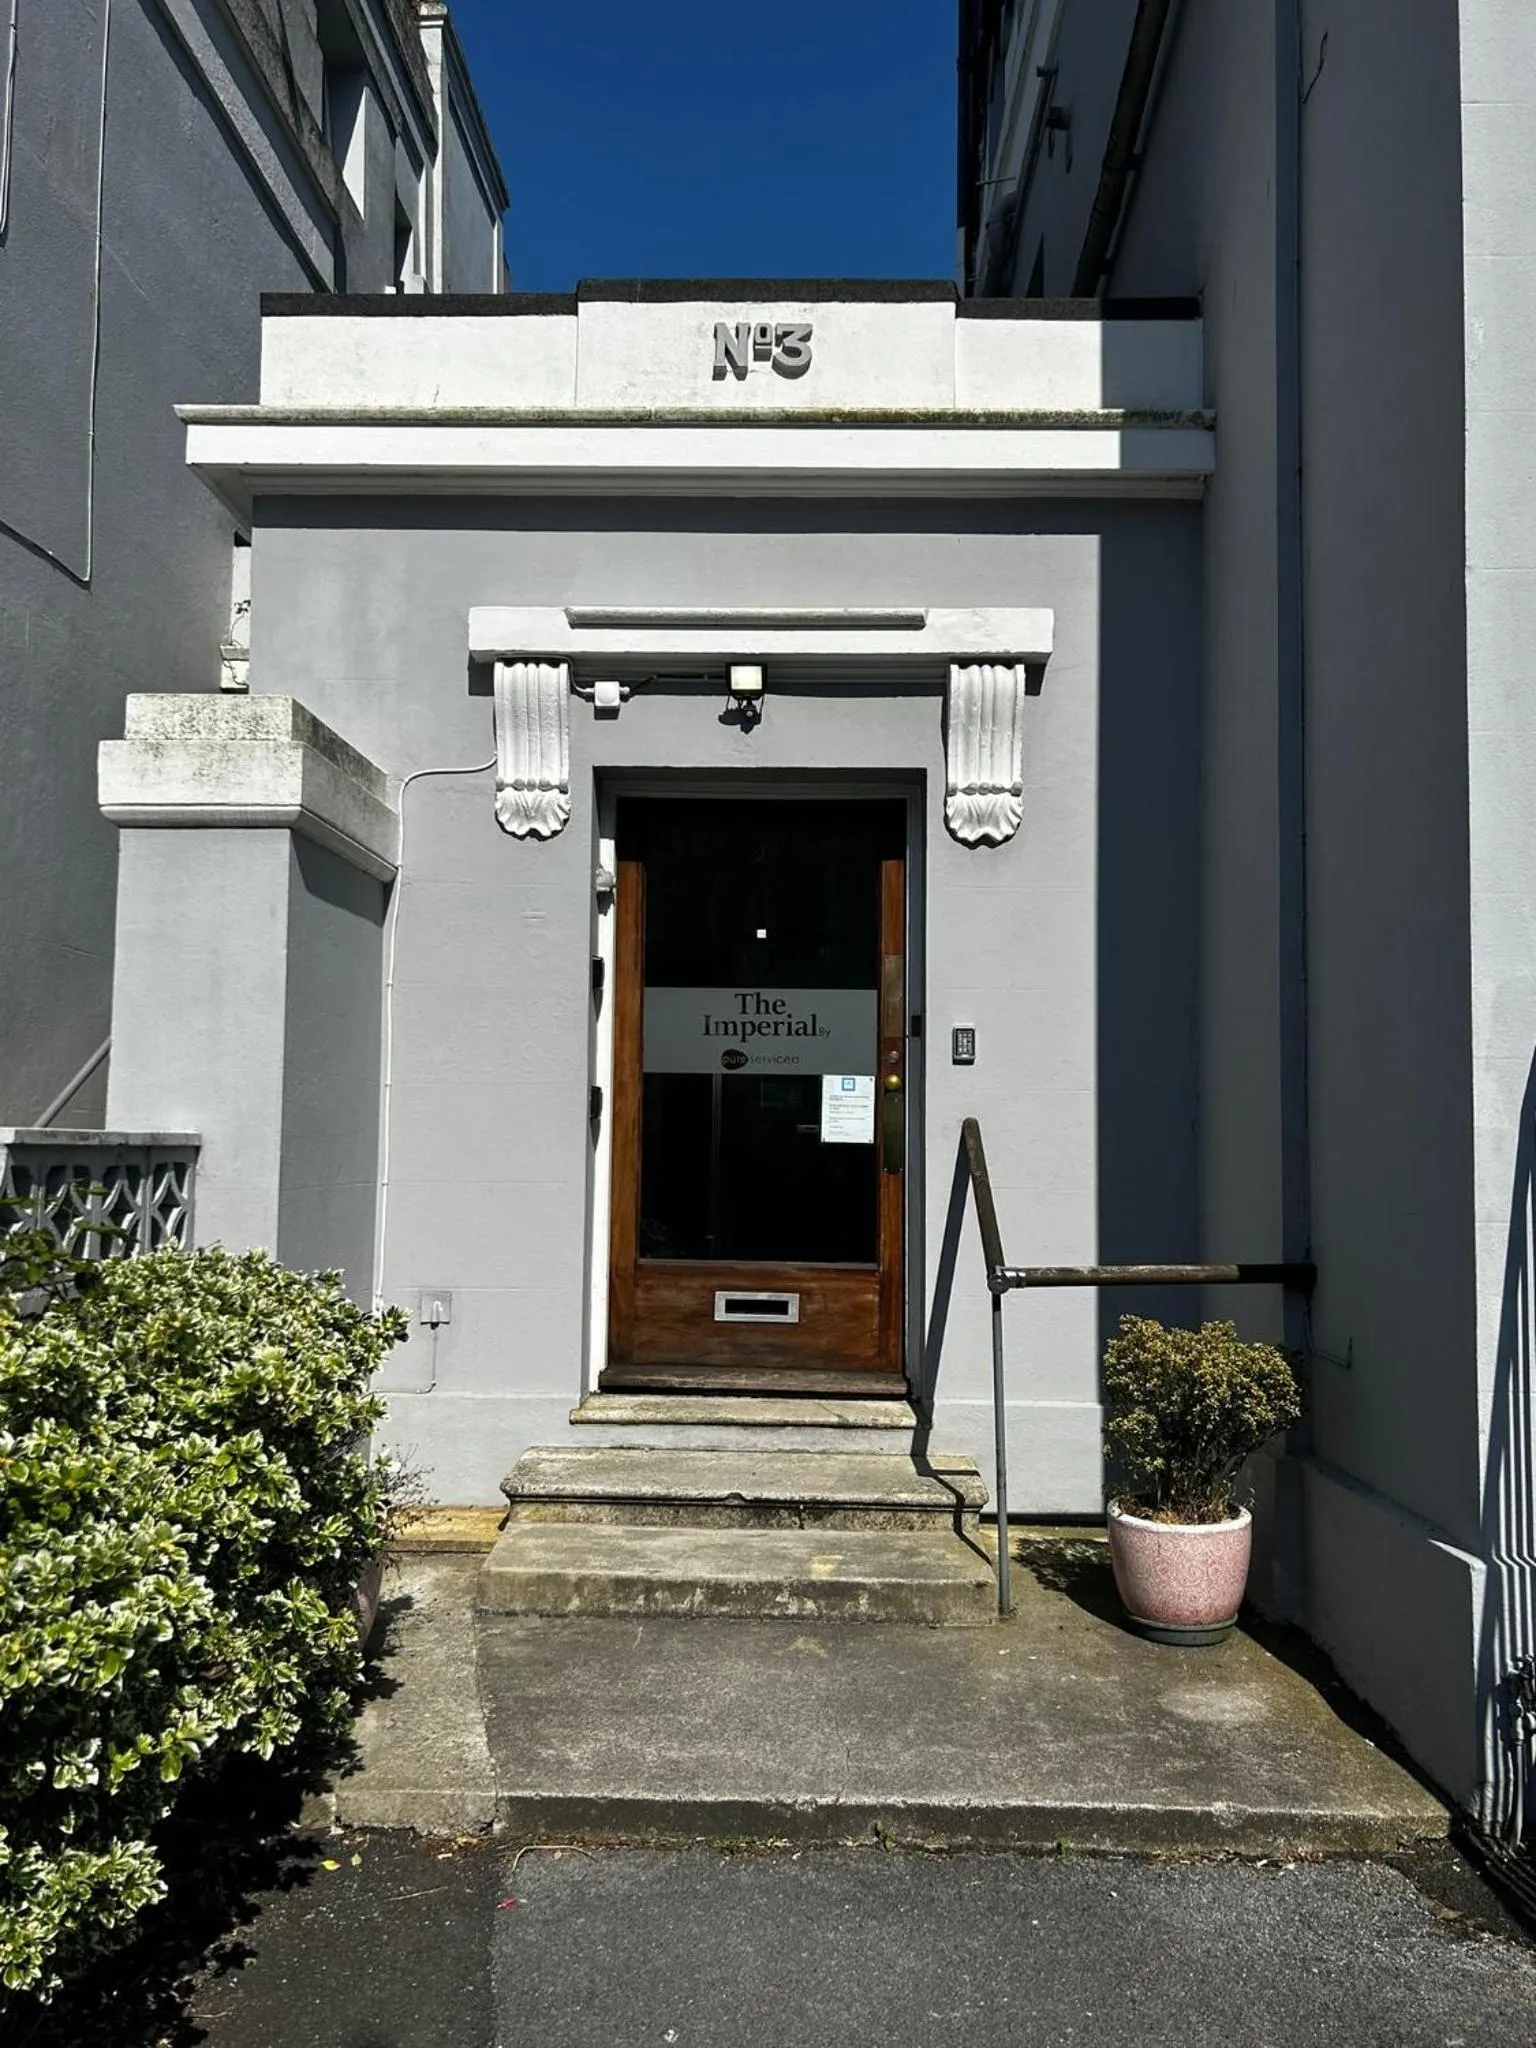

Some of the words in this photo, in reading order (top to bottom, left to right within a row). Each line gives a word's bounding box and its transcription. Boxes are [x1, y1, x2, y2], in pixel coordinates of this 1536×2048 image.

[734, 991, 787, 1015] The
[702, 1013, 818, 1043] Imperial
[818, 1026, 832, 1038] By
